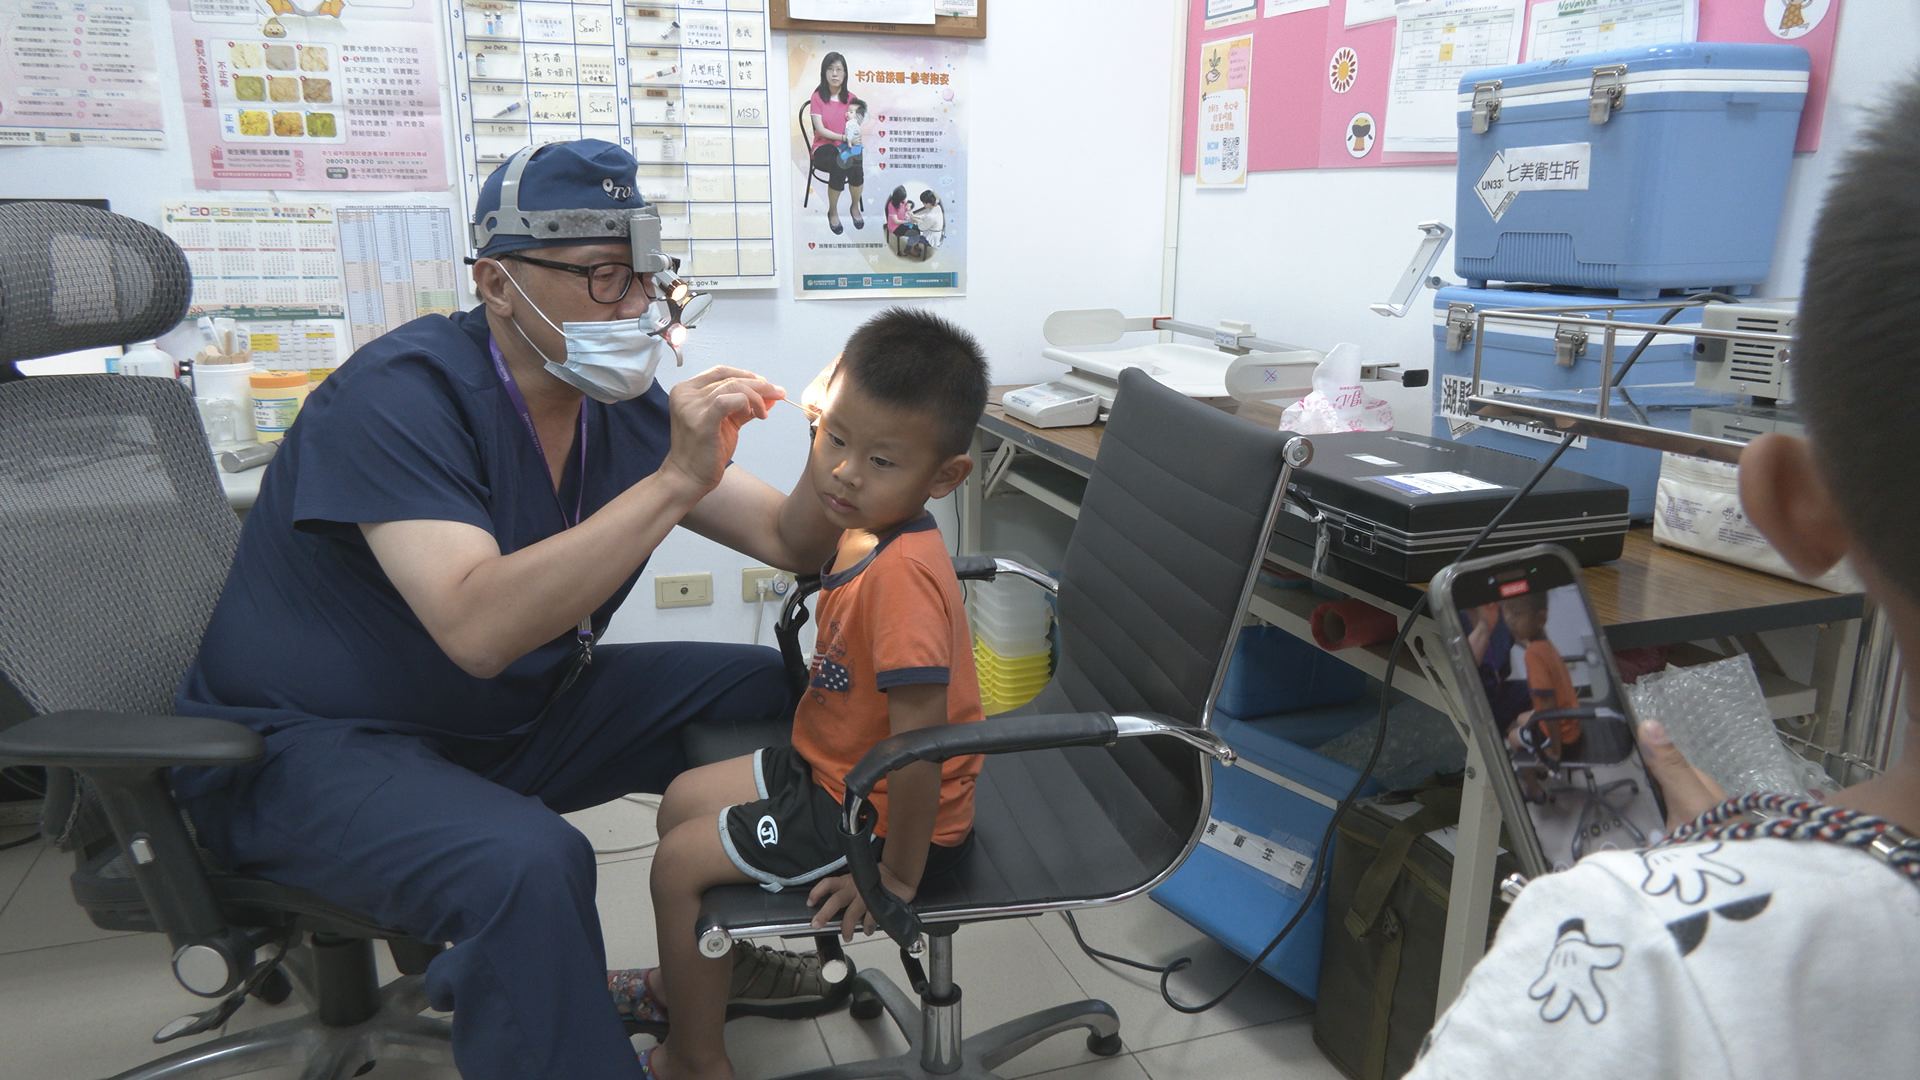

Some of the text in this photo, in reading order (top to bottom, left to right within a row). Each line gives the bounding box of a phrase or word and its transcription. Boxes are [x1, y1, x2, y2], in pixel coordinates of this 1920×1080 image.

[453, 10, 460, 18] 3
[615, 17, 623, 25] 12
[457, 52, 463, 60] 4
[617, 58, 626, 66] 13
[461, 93, 467, 101] 5
[620, 97, 628, 105] 14
[736, 108, 760, 119] MSD
[224, 113, 235, 134] 正常
[465, 134, 471, 142] 6
[622, 136, 631, 145] 15
[1506, 160, 1580, 182] 七美衛生所
[469, 174, 474, 182] 7
[190, 207, 231, 216] 2025
